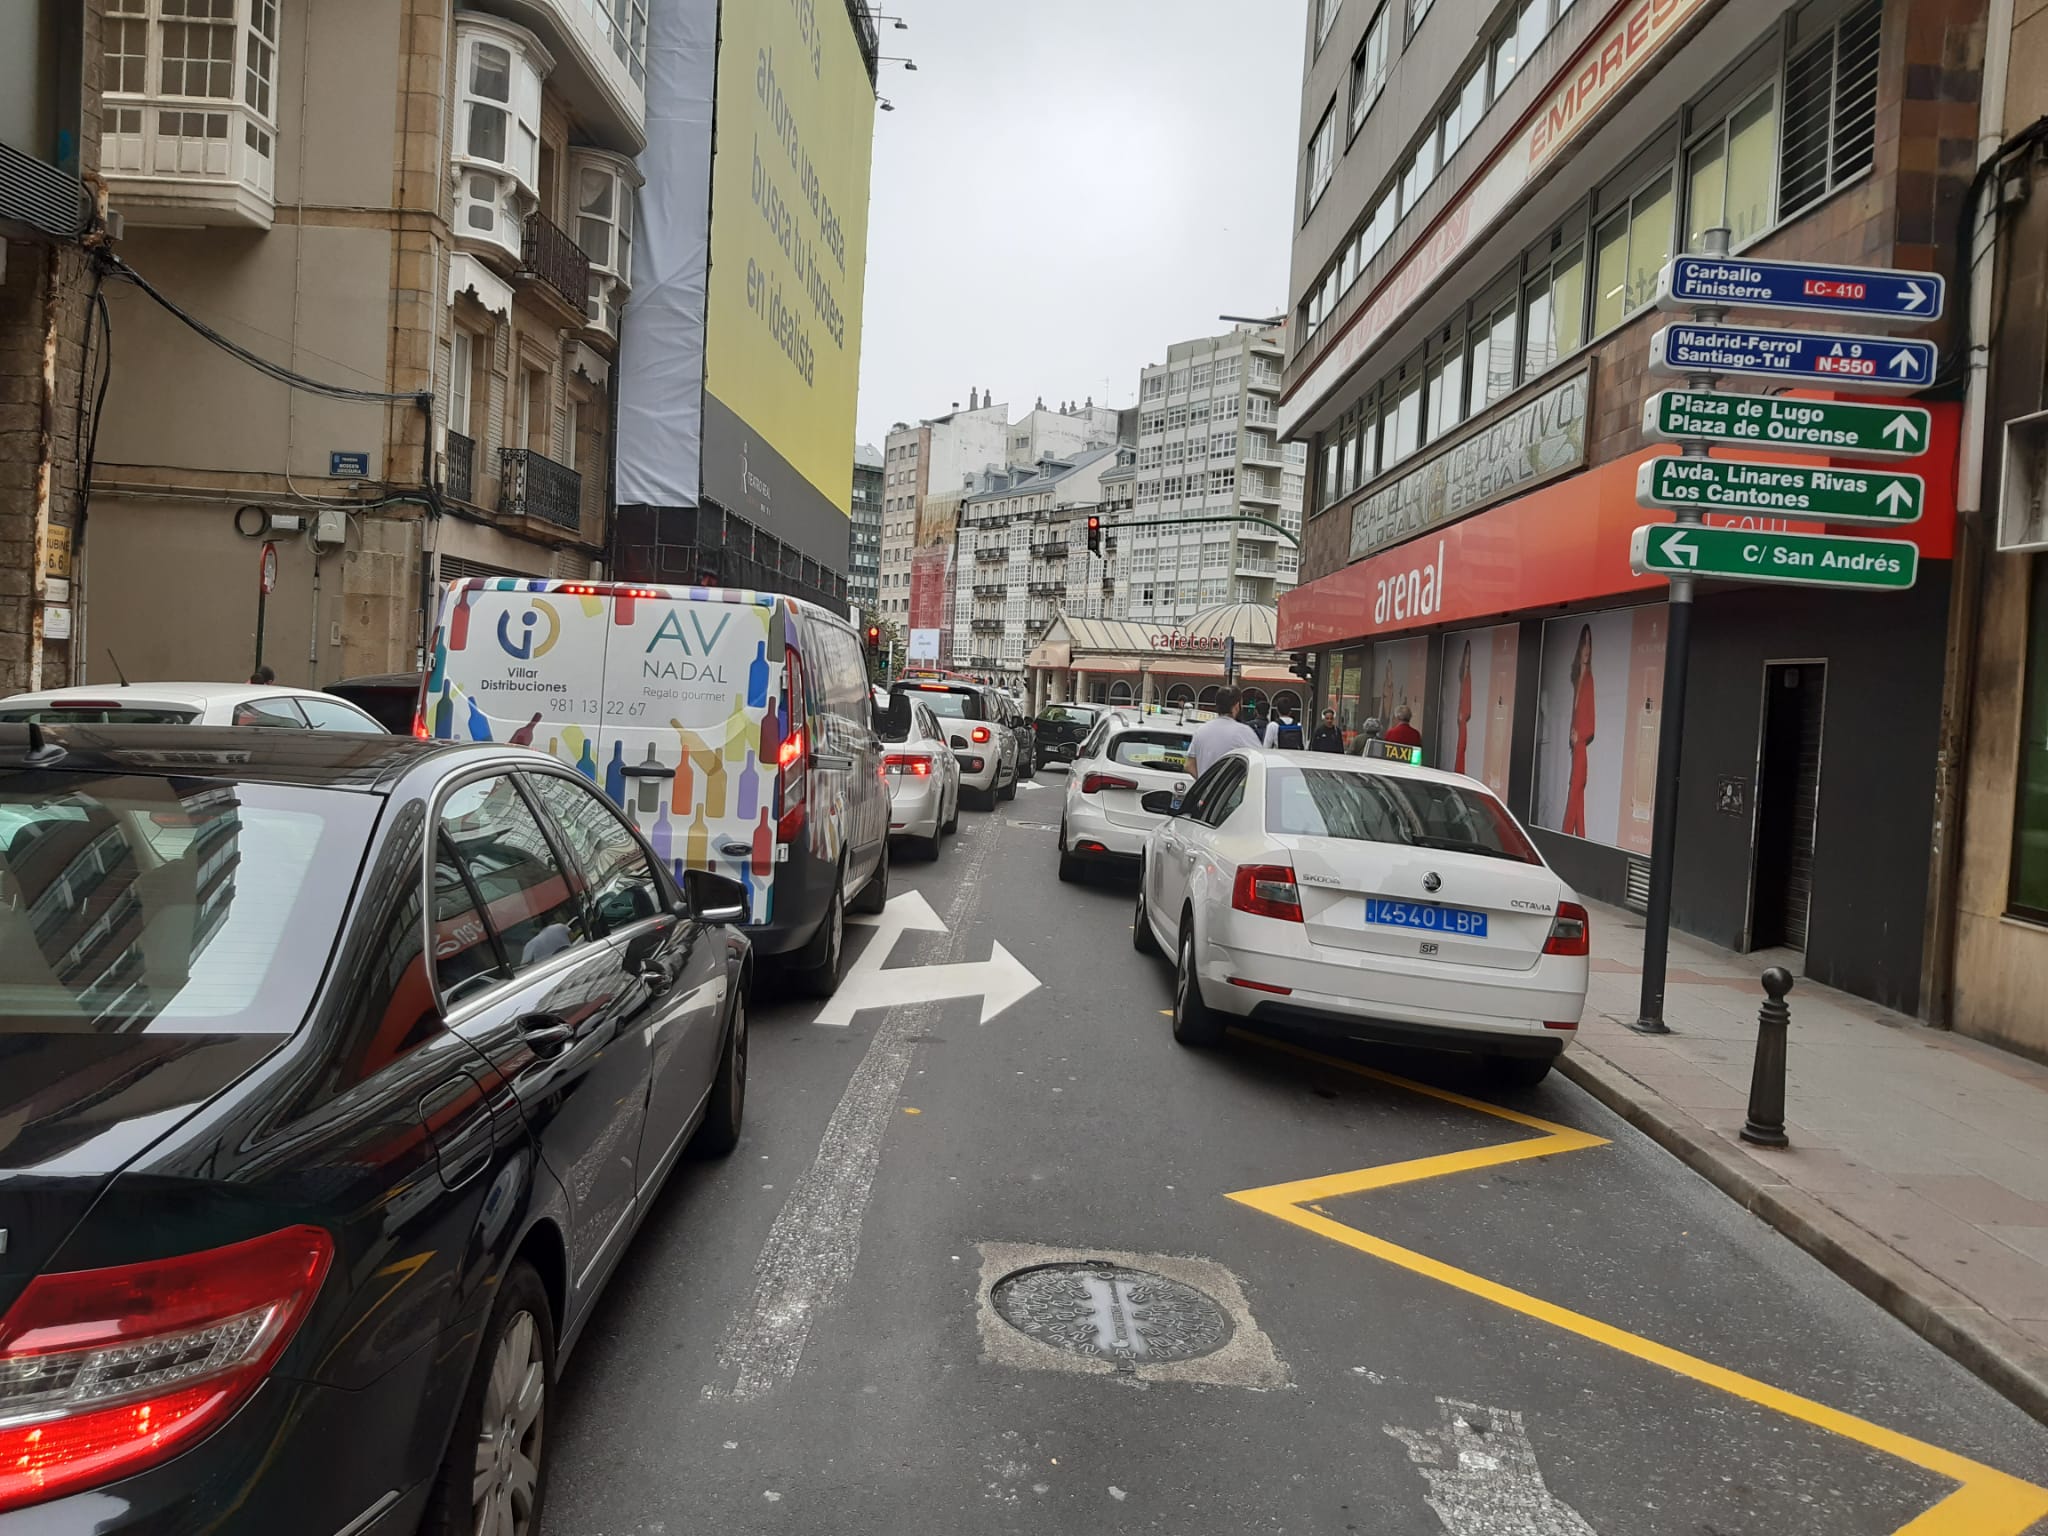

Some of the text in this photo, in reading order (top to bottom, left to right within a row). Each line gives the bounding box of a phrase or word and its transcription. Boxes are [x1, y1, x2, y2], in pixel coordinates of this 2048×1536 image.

[756, 46, 799, 174] ahorra
[801, 145, 820, 219] una
[751, 132, 845, 351] busca tu hipoteca
[1686, 264, 1761, 283] Carballo
[1685, 280, 1772, 299] Finisterre
[747, 257, 815, 389] en idealista
[1678, 331, 1802, 353] Madrid-Ferrol
[1830, 343, 1863, 358] A 9
[1678, 347, 1790, 368] Santiago-Tui
[1818, 357, 1874, 375] N-550
[1670, 395, 1824, 424] Plaza de Lugo
[1452, 384, 1575, 484] DEPORTIVO
[1668, 414, 1859, 445] Plaza de Ourense
[1663, 461, 1868, 493] Avda. Linares Rivas
[1661, 481, 1810, 508] Los Cantones
[1743, 545, 1901, 573] C/ San Andrés
[1374, 540, 1445, 625] arenal
[645, 608, 732, 657] AV
[1151, 630, 1227, 652] cafeteri
[508, 667, 538, 679] Villar
[643, 660, 728, 684] NADAL
[481, 679, 567, 693] Distribuciones
[643, 686, 726, 702] Regalo gourmet
[550, 698, 647, 716] 981 13 22 67
[1384, 744, 1412, 764] TAXI
[1511, 899, 1552, 912] OCTAVIA
[1380, 902, 1436, 927] 4540
[1443, 910, 1483, 933] LBP
[1421, 944, 1438, 953] SP
